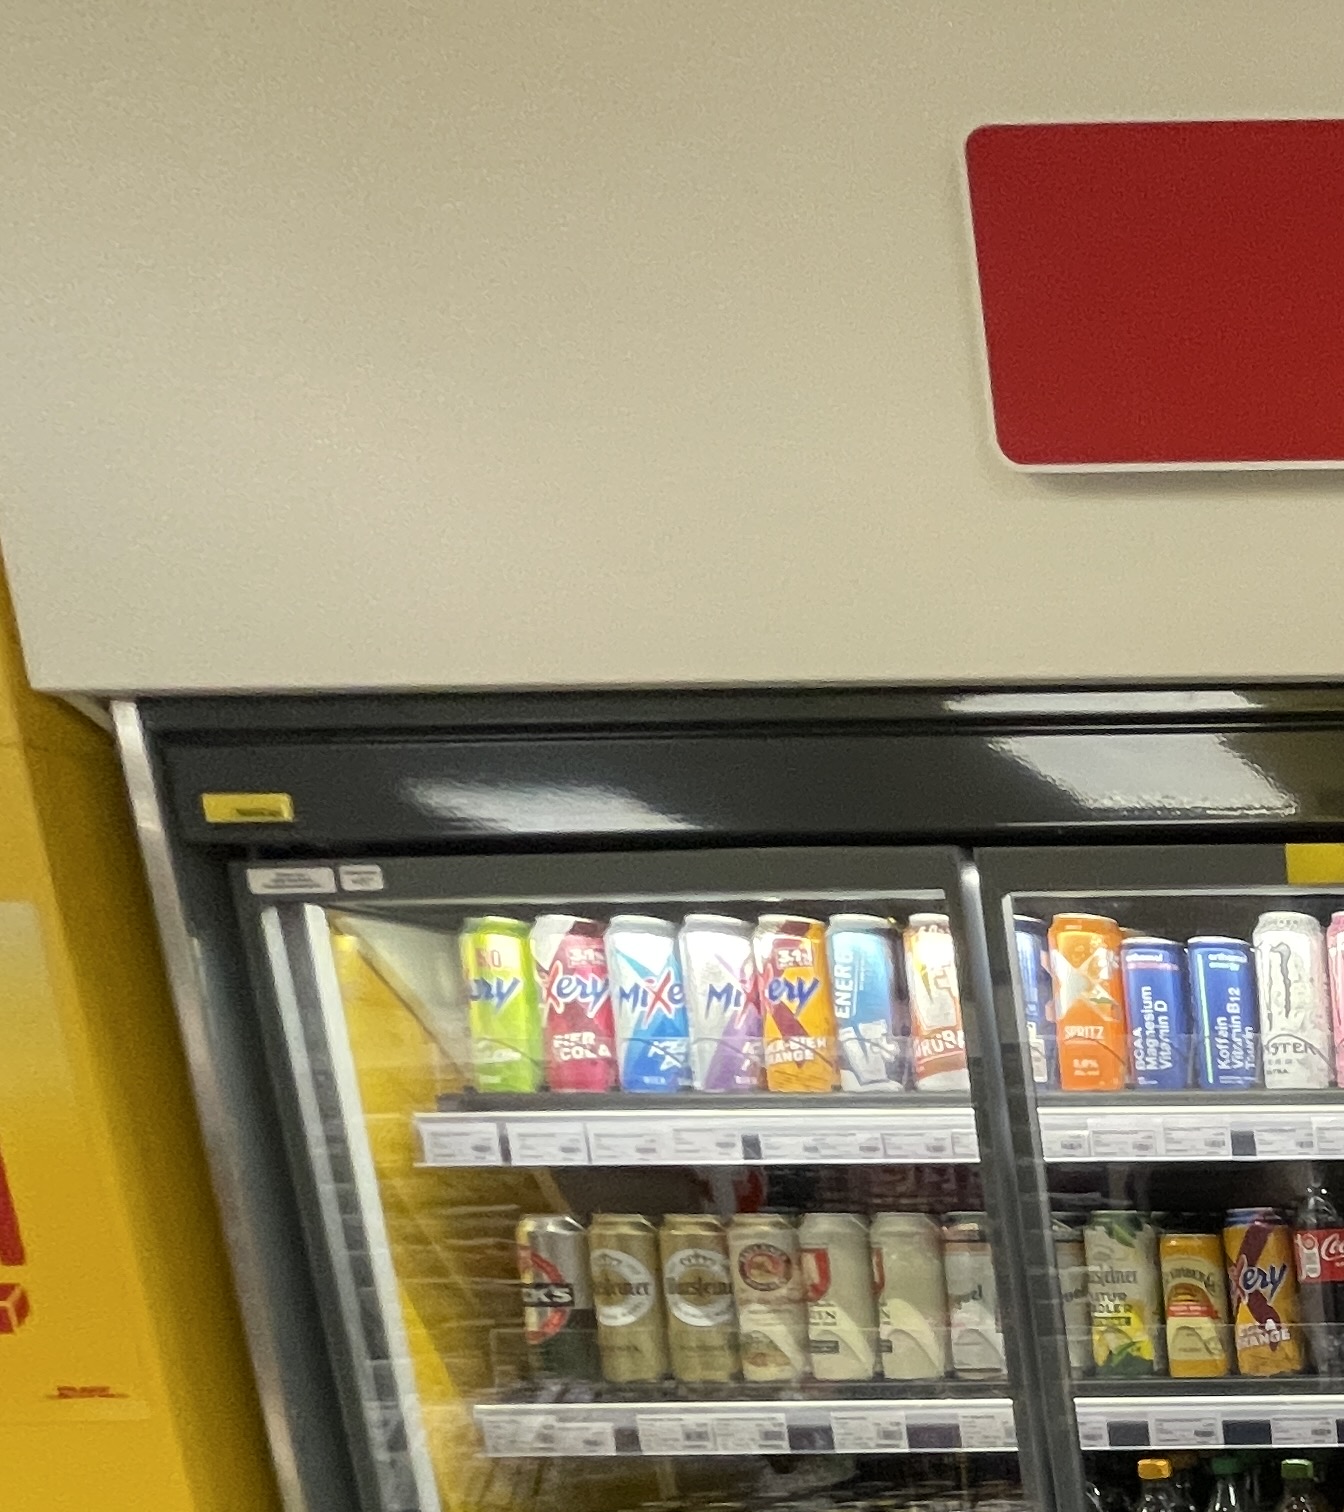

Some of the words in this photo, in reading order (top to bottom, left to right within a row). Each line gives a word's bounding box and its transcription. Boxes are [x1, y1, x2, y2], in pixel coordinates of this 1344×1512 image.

[1154, 1000, 1168, 1012] D
[1226, 987, 1241, 1014] B12
[1141, 985, 1159, 1070] Magnesium
